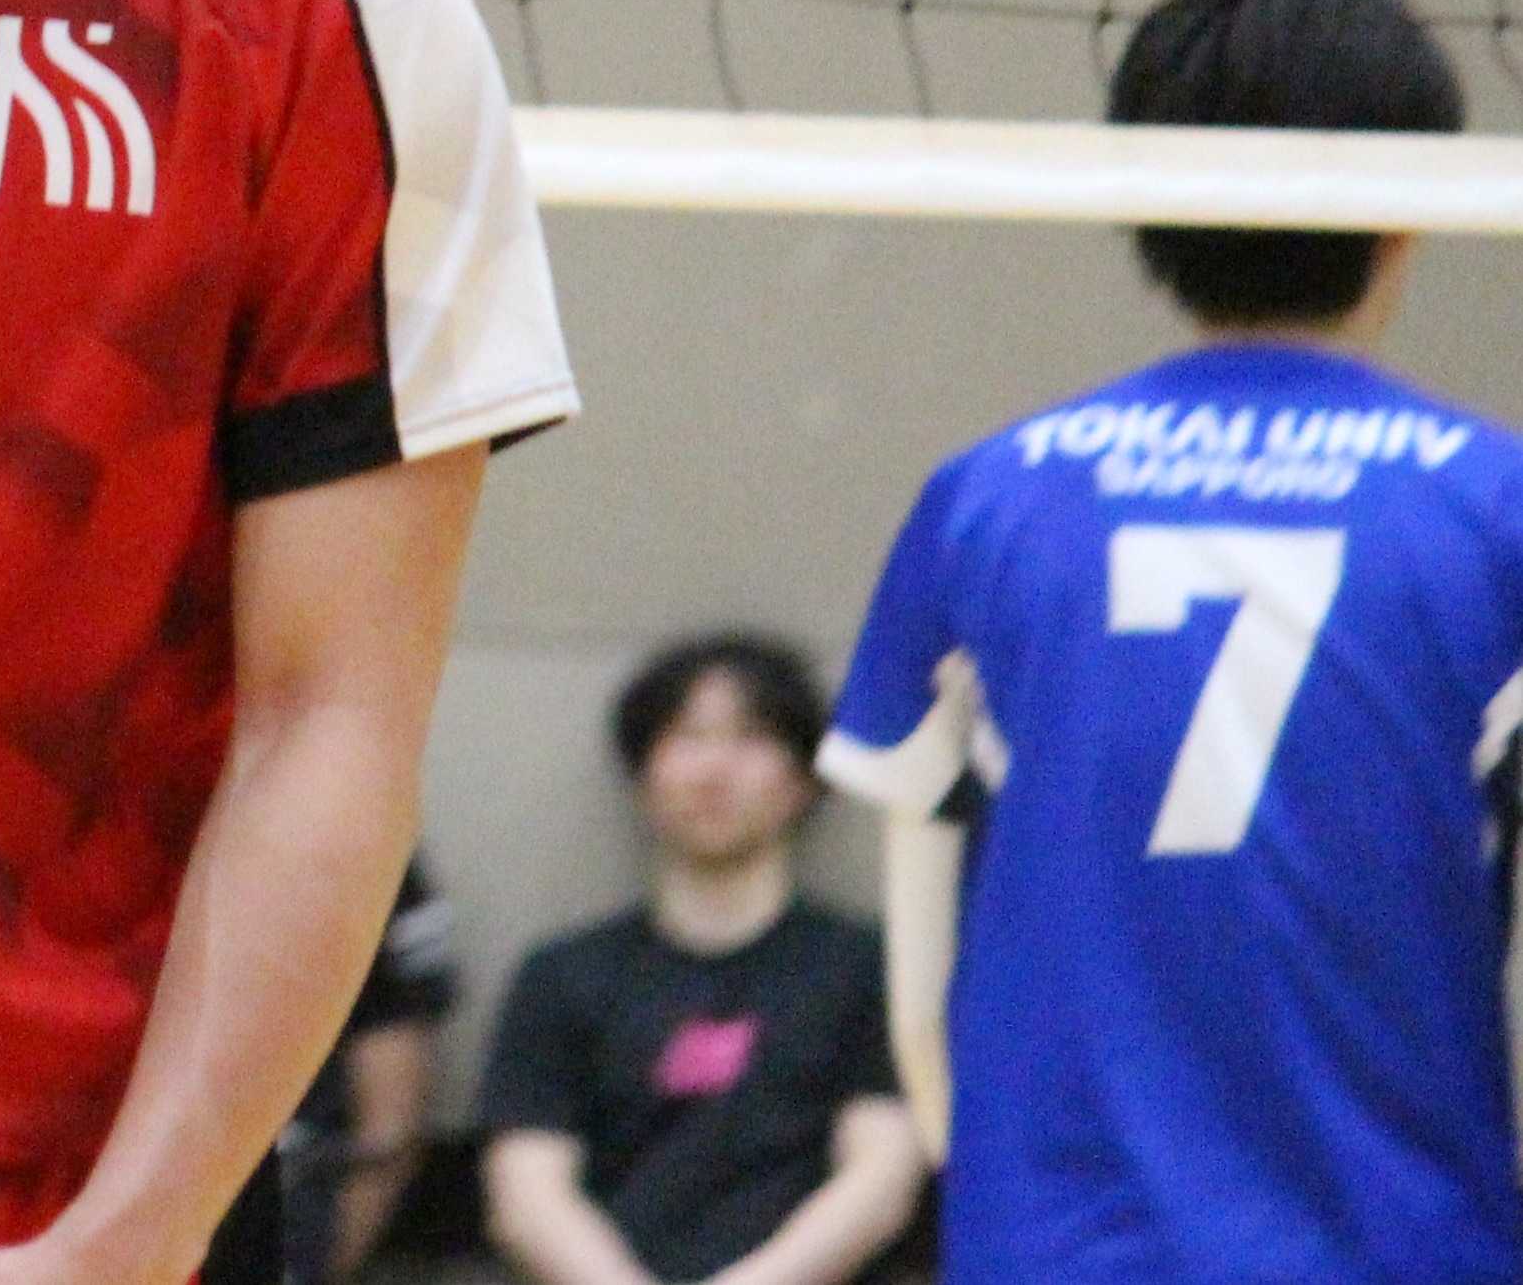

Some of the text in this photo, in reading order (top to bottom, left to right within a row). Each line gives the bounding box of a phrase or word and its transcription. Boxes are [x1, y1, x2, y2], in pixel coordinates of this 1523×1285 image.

[1015, 402, 1473, 469] TOKAI UNIV
[1106, 524, 1347, 856] 7
